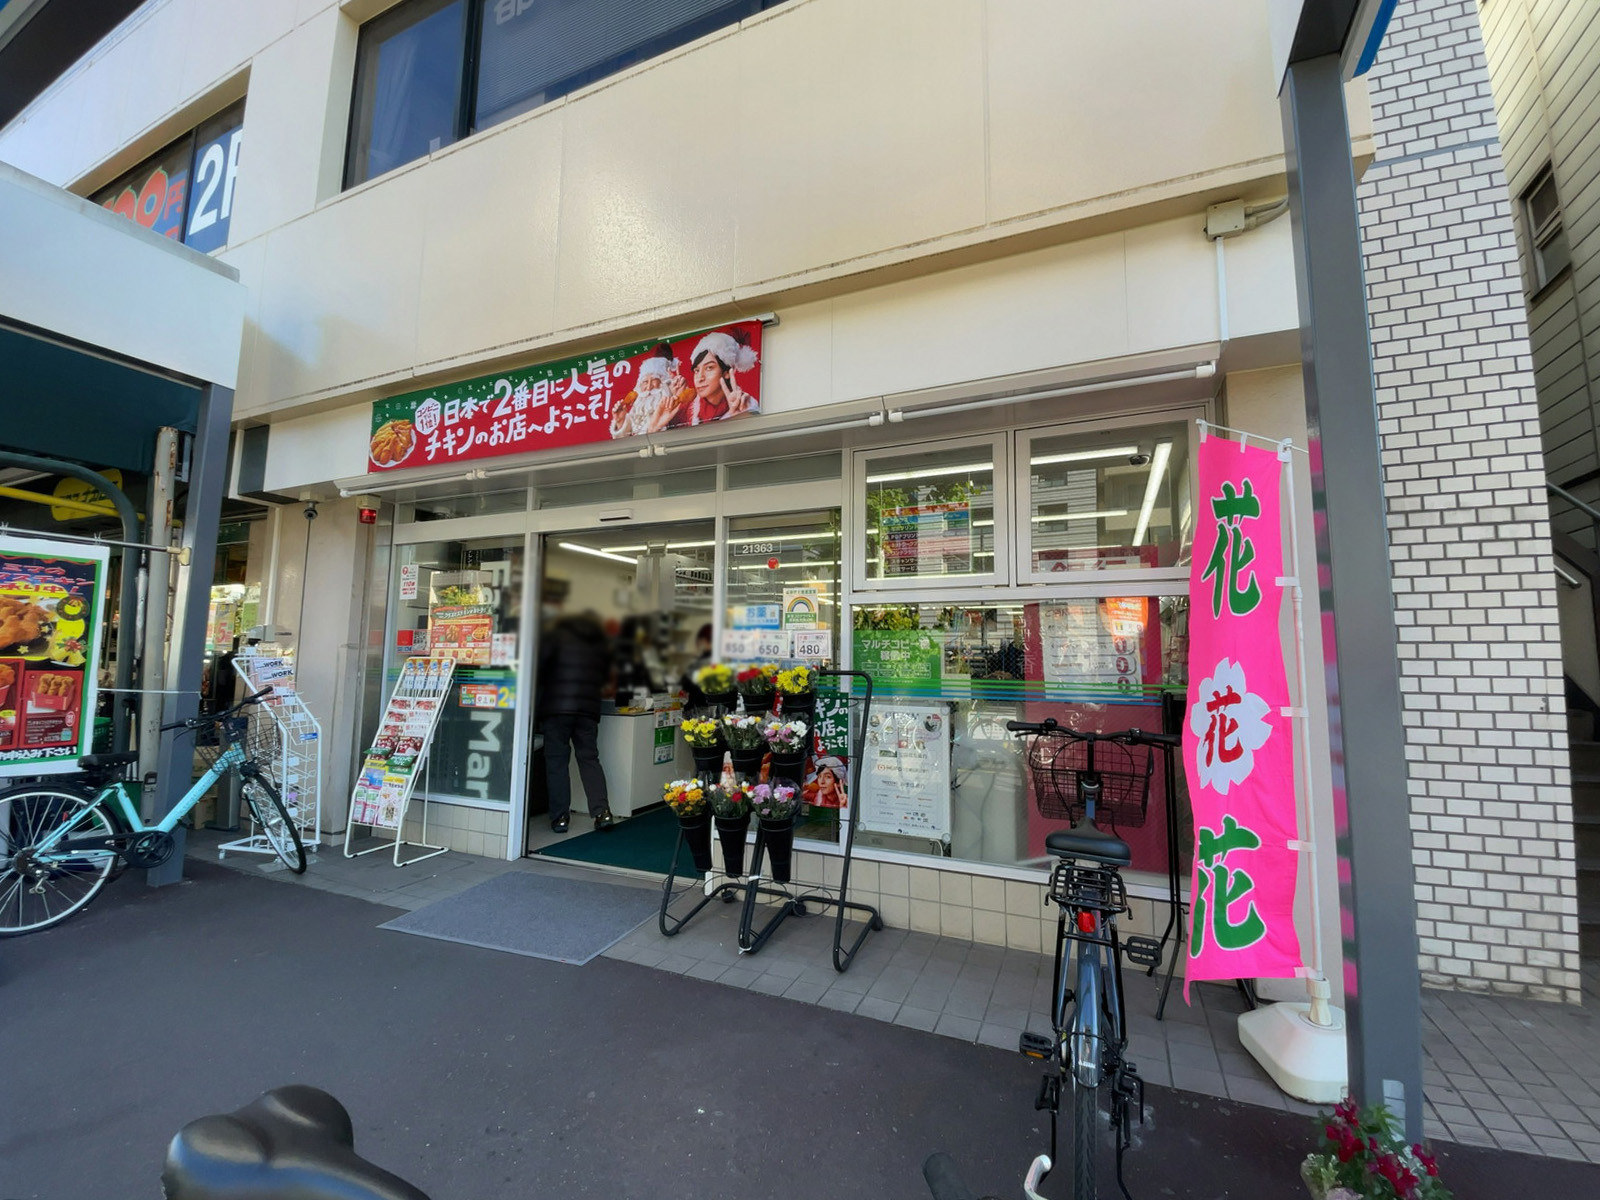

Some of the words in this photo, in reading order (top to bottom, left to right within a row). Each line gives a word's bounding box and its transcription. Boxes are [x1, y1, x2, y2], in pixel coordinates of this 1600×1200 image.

[443, 359, 631, 425] 日本で2番目に人気の
[425, 393, 612, 461] チキンのお店へようこそ!
[742, 543, 773, 554] 21363
[1201, 478, 1263, 619] 花
[758, 645, 779, 655] 650
[799, 644, 820, 654] 480
[263, 660, 284, 668] WORK
[271, 669, 294, 678] WORK
[1202, 684, 1245, 768] 花
[817, 735, 848, 752] ようこそ!
[1190, 815, 1266, 959] 花
